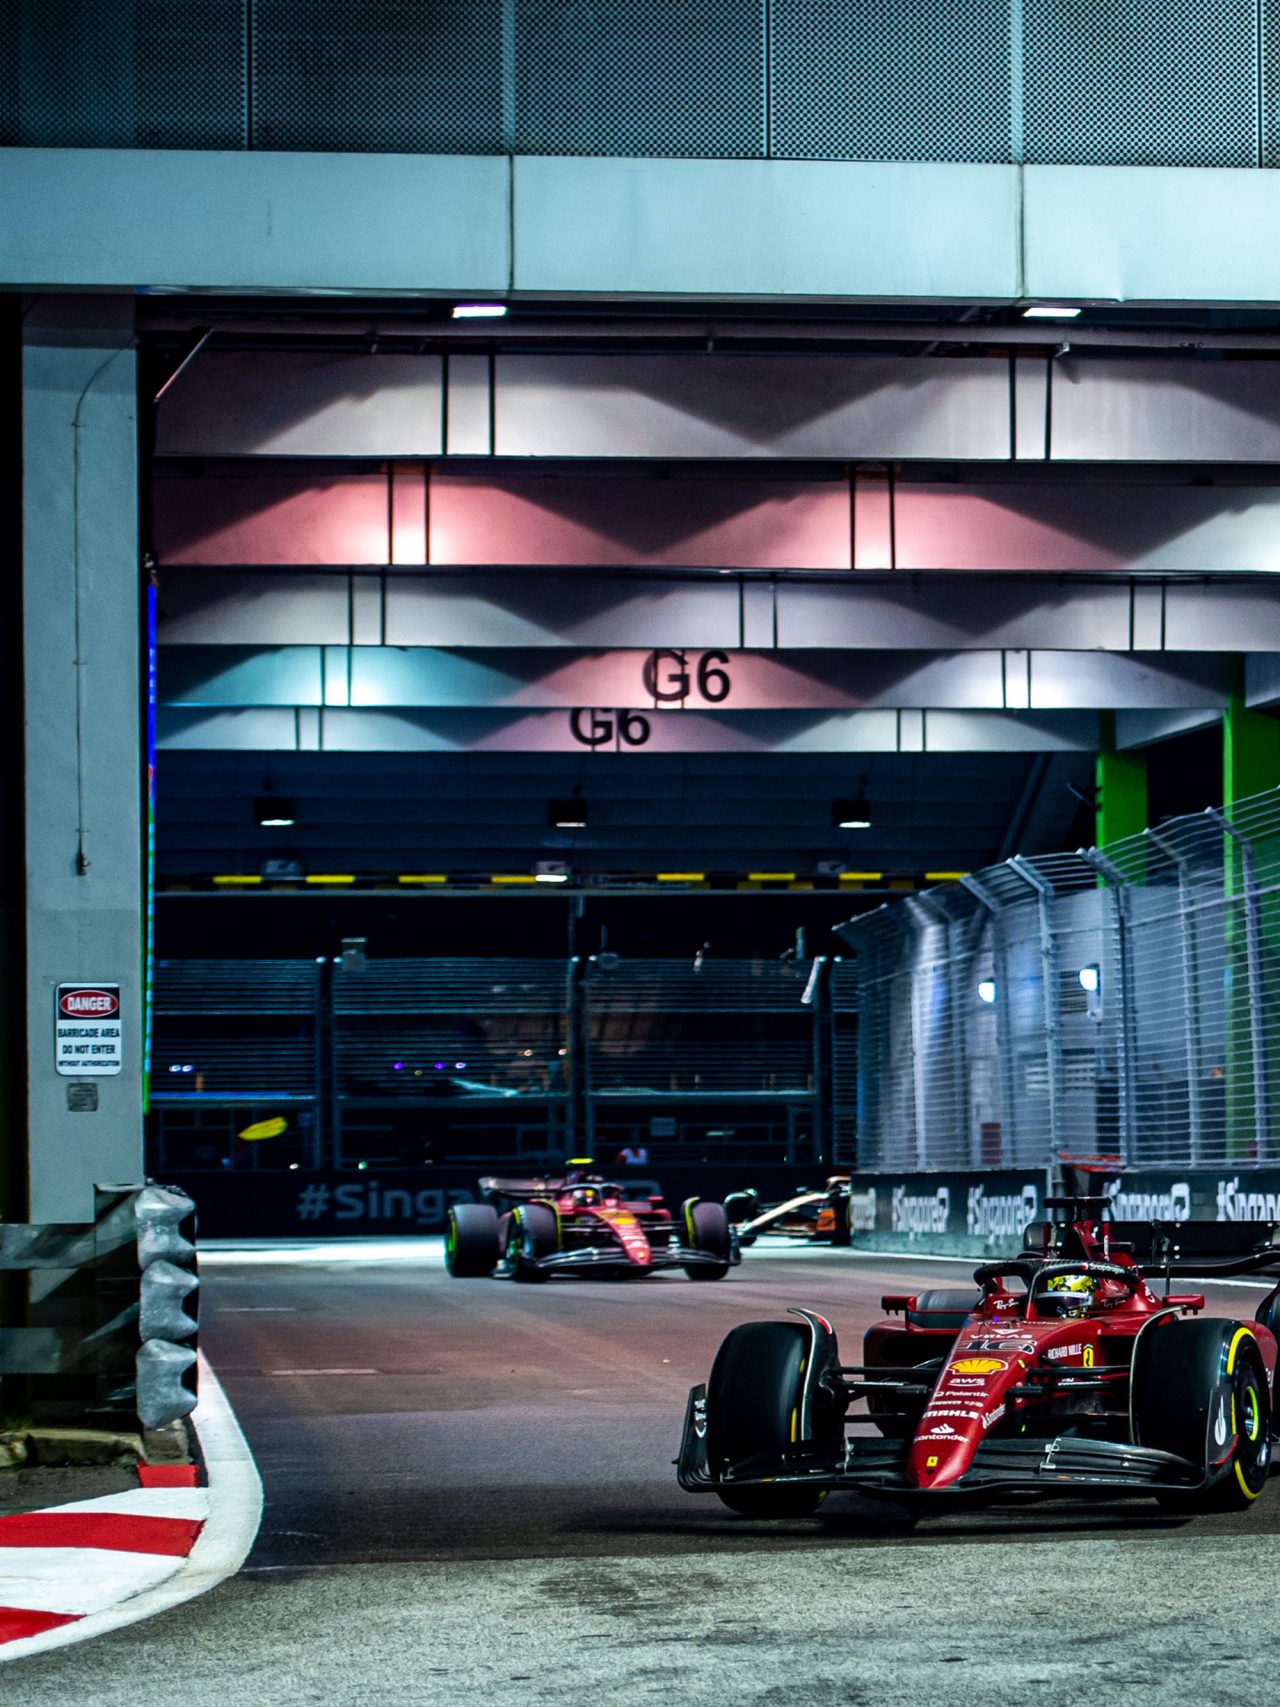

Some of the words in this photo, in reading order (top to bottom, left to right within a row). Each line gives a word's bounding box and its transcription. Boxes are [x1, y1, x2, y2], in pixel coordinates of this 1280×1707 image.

[642, 650, 731, 703] G6
[570, 708, 650, 746] G6
[67, 996, 112, 1011] DANGER
[57, 1027, 99, 1038] BARRICADE
[100, 1027, 120, 1038] AREA
[62, 1044, 73, 1054] DO
[75, 1044, 90, 1054] NOT
[91, 1044, 116, 1054] ENTER
